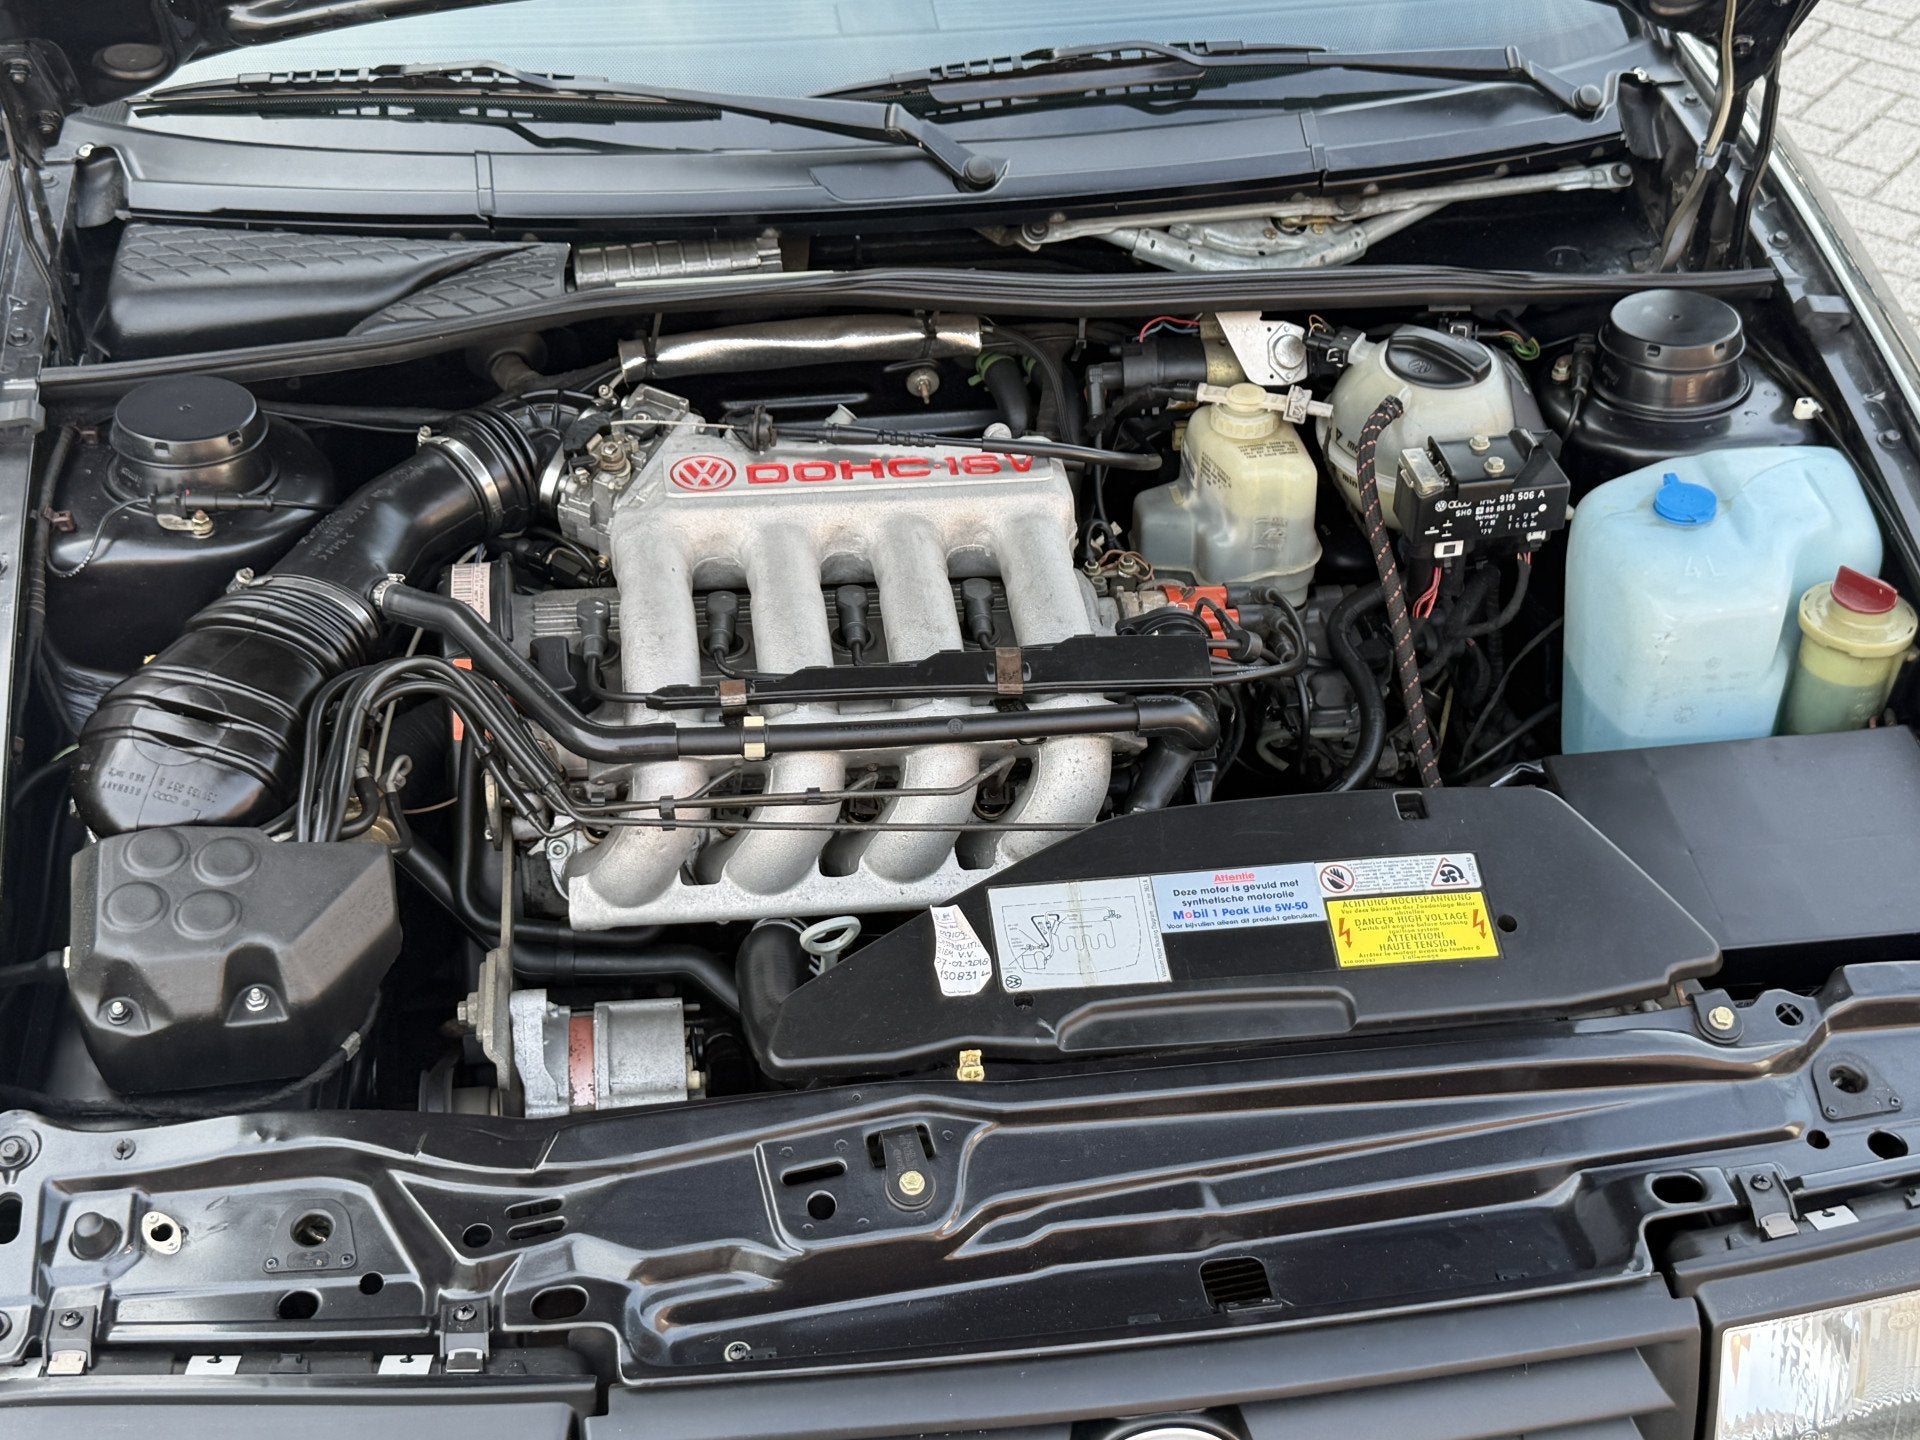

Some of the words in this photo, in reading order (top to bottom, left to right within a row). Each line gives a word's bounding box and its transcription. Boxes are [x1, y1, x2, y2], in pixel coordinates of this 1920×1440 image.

[1342, 473, 1358, 489] min
[1499, 493, 1515, 503] 919
[1517, 490, 1535, 501] 506
[1537, 489, 1545, 498] A
[1213, 871, 1256, 883] Attentie
[1173, 889, 1197, 897] Deze
[1200, 885, 1229, 895] motor
[1232, 884, 1240, 892] is
[1242, 881, 1277, 893] gevuld
[1279, 879, 1299, 888] met
[1182, 895, 1244, 907] synthetische
[1247, 890, 1295, 901] motorolie
[1342, 898, 1388, 908] ACHTUNG
[1391, 893, 1472, 906] HOCHSPANNUNG
[1173, 908, 1209, 920] Mobil
[1212, 909, 1218, 917] 1
[1222, 906, 1250, 916] Peak
[1253, 903, 1272, 914] Life
[1275, 901, 1309, 912] 5W-50
[1185, 920, 1215, 929] bijvullen
[1217, 918, 1239, 926] alleen
[1252, 915, 1280, 924] produkt
[1354, 916, 1394, 927] DANGER
[1398, 914, 1423, 923] HIGH
[1425, 912, 1468, 922] VOLTAGE
[1439, 919, 1469, 927] touching
[1387, 932, 1445, 943] ATTENTION!
[1379, 942, 1411, 951] HAUTE
[1413, 939, 1457, 949] TENSION
